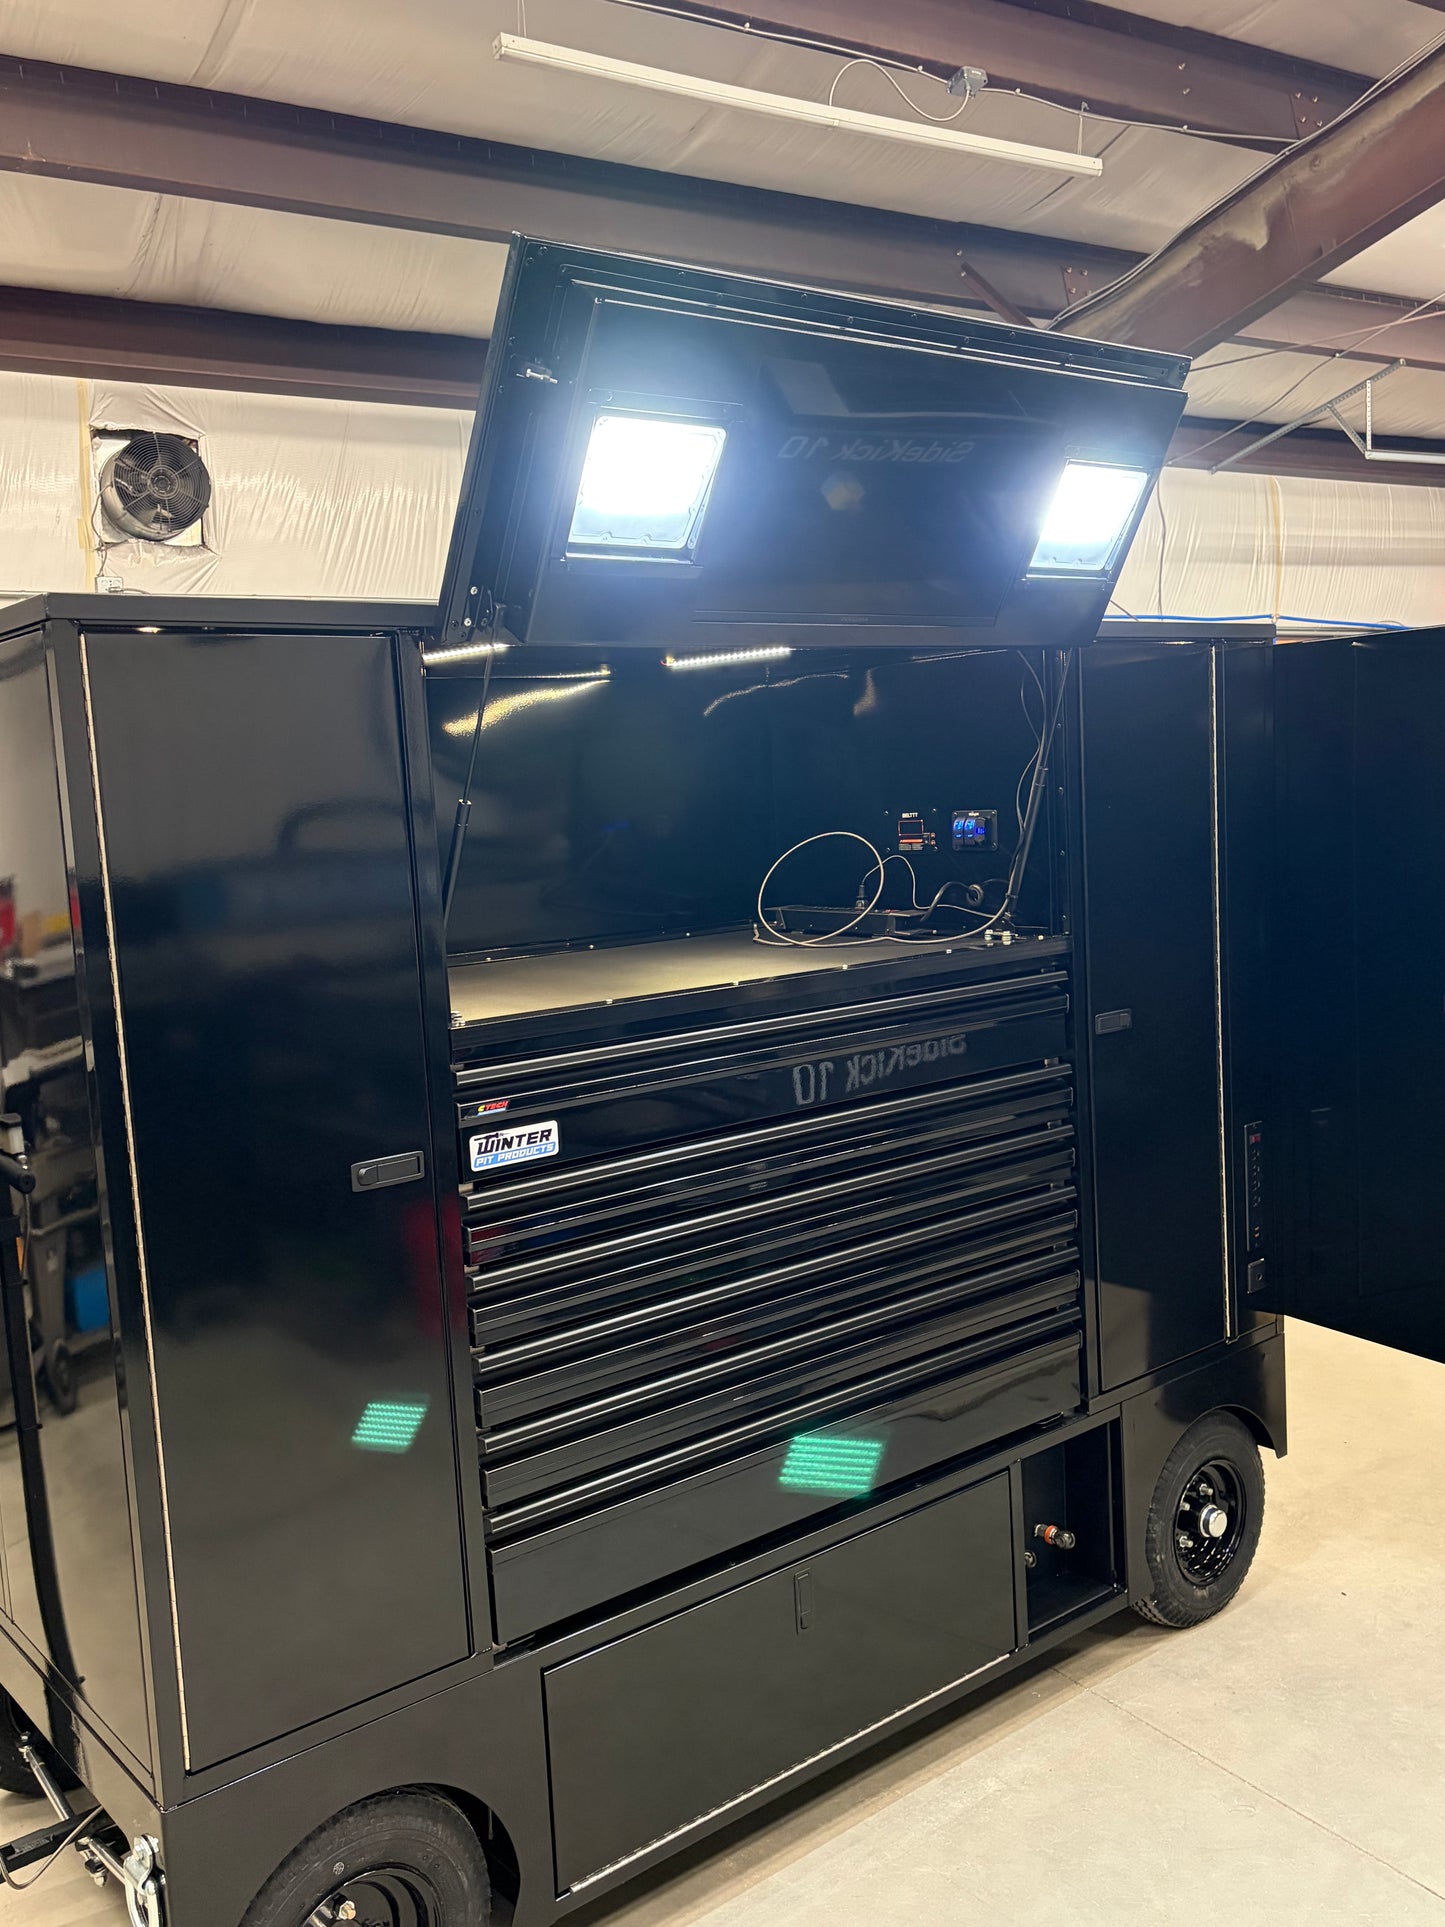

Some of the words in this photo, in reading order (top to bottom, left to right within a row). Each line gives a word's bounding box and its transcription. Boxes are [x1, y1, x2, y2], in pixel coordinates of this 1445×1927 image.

[476, 1156, 495, 1166] PIT
[497, 1143, 555, 1163] PRODUCTS
[477, 1128, 552, 1156] WINTER
